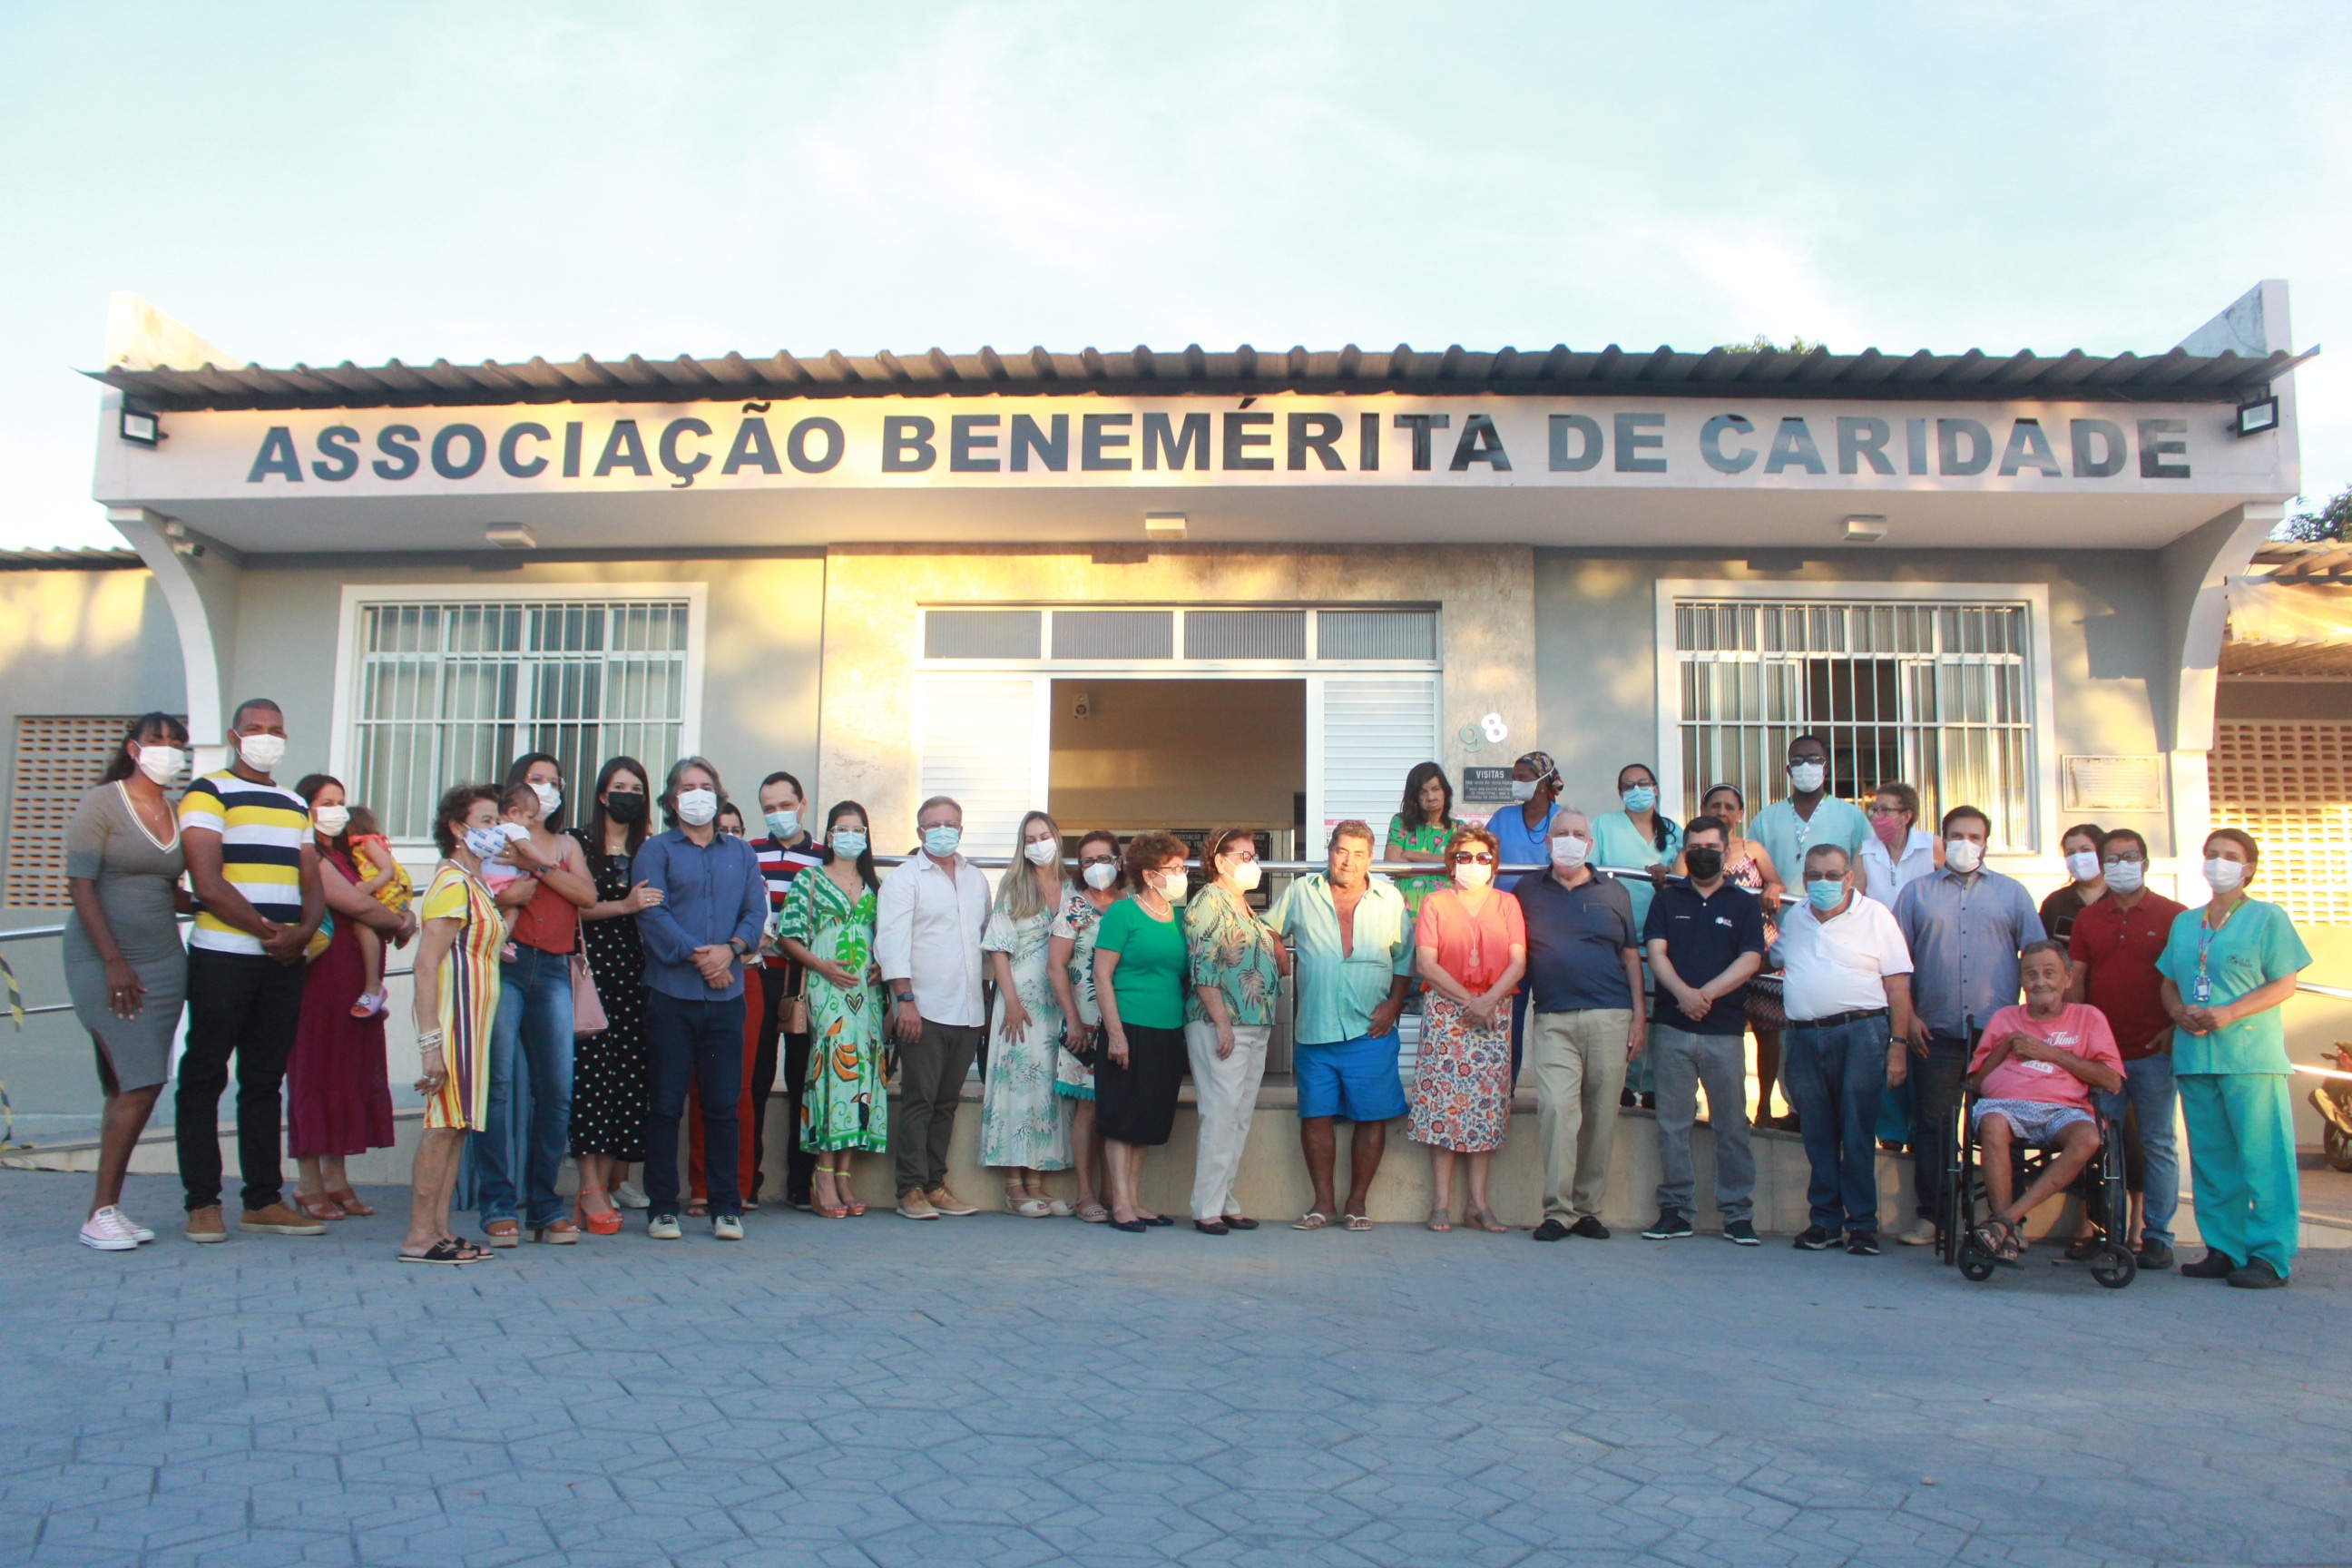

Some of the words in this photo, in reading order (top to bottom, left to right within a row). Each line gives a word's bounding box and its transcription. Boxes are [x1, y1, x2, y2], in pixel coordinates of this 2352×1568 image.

[246, 401, 846, 488] ASSOCIAÇÃO
[880, 397, 1514, 474] BENEMÉRITA
[1548, 412, 1668, 473] DE
[1699, 413, 2192, 480] CARIDADE
[1475, 769, 1504, 779] VISITAS
[2051, 1031, 2080, 1046] Time
